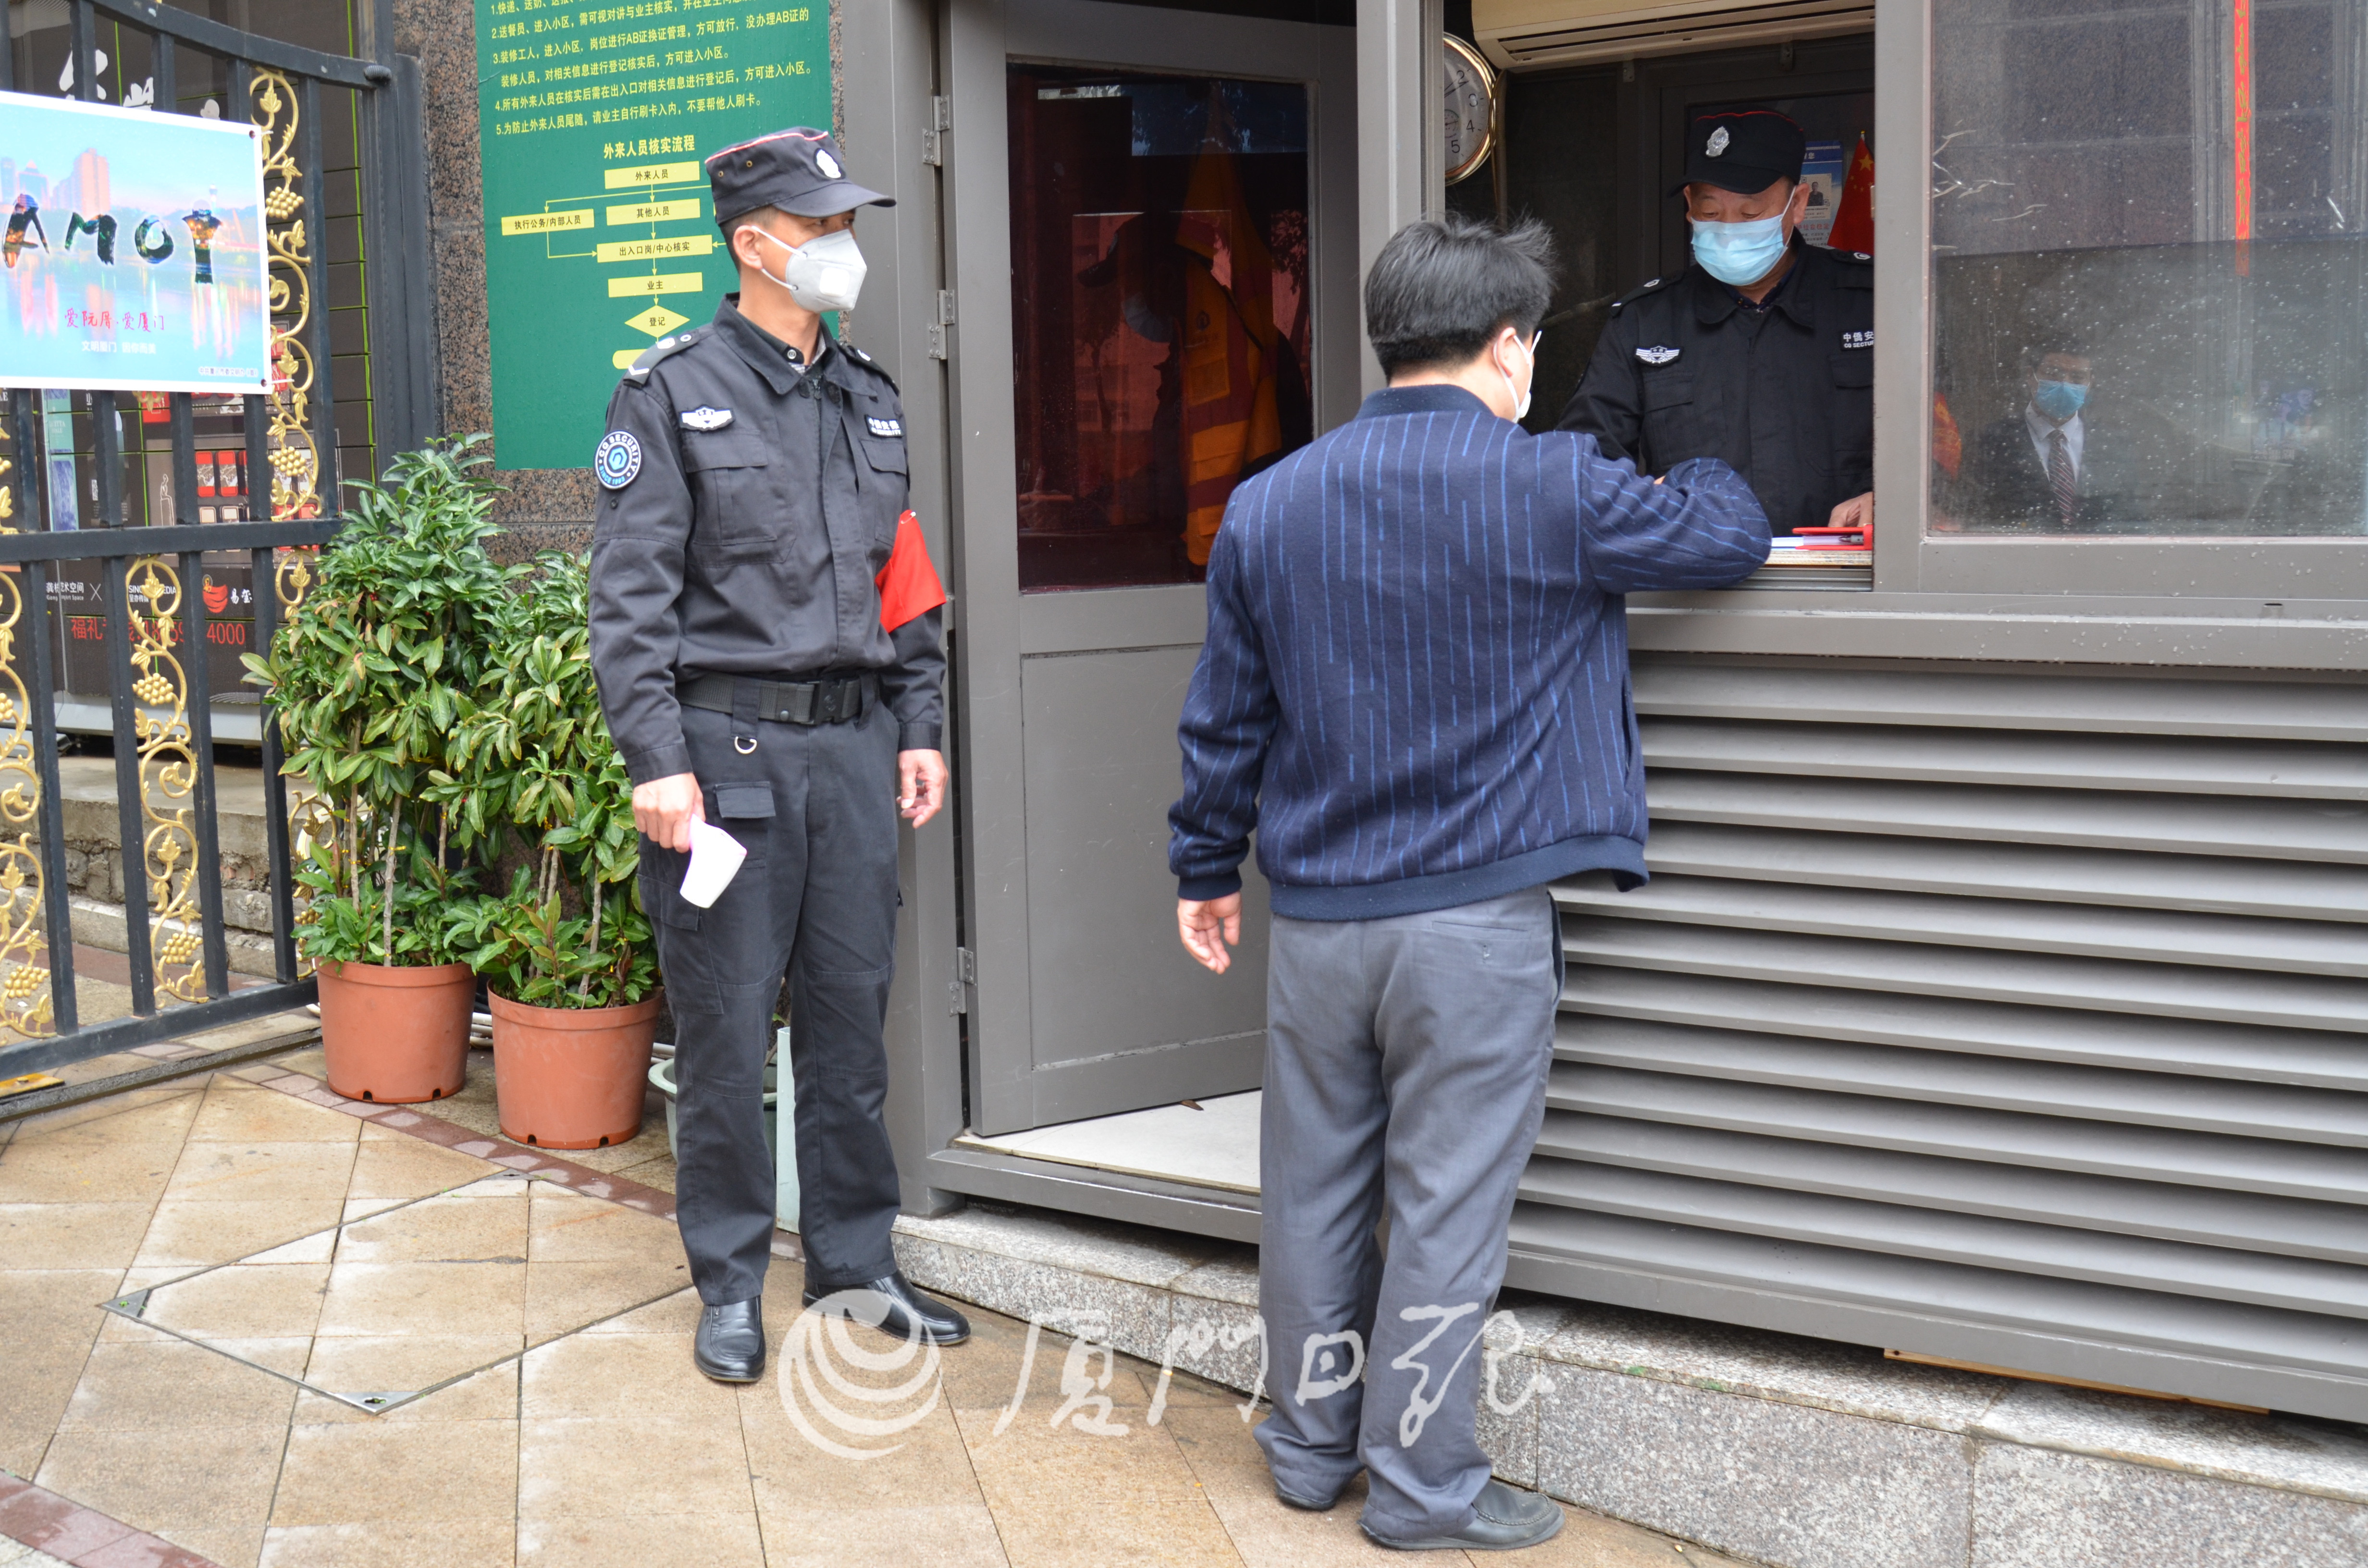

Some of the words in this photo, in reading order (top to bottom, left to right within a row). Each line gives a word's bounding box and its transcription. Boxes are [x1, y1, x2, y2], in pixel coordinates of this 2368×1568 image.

[501, 46, 728, 87] 装修人员，对相关信息进行登记核实后，方可进入小区。
[1468, 94, 1478, 107] 3
[1466, 119, 1475, 132] 4
[604, 135, 695, 159] 外来人员核实流程
[1451, 139, 1460, 153] 5
[635, 169, 668, 181] 外来人员
[636, 206, 670, 218] 其他人员
[515, 215, 581, 230] 执行公务/内部人员
[619, 241, 690, 256] 出入口岗/中心核实
[647, 280, 664, 291] 业主
[649, 317, 666, 327] 登记
[609, 434, 639, 472] SECURITY
